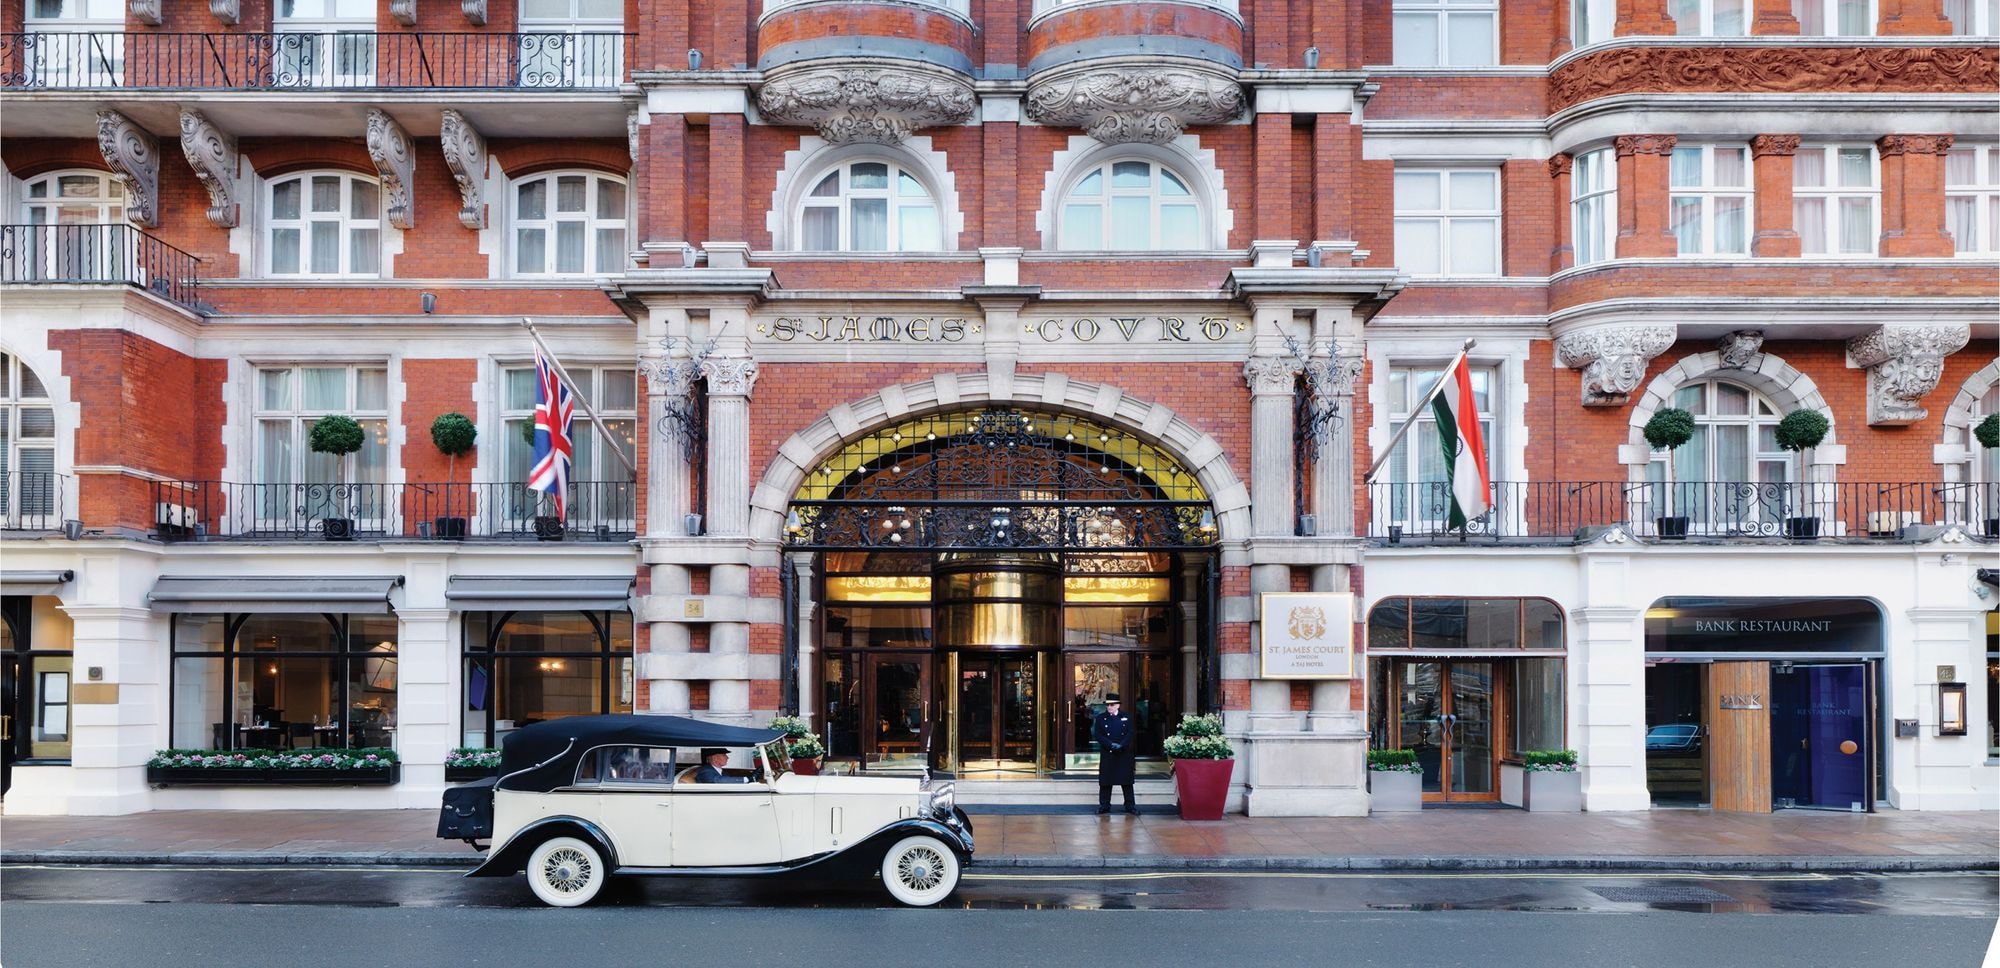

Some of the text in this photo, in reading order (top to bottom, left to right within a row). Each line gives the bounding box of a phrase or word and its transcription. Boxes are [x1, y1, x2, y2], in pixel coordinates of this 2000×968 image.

[1696, 620, 1831, 632] BANK RESTAURANT
[1283, 646, 1311, 654] JAMES
[1313, 646, 1345, 654] COURT
[1720, 695, 1760, 706] BANK
